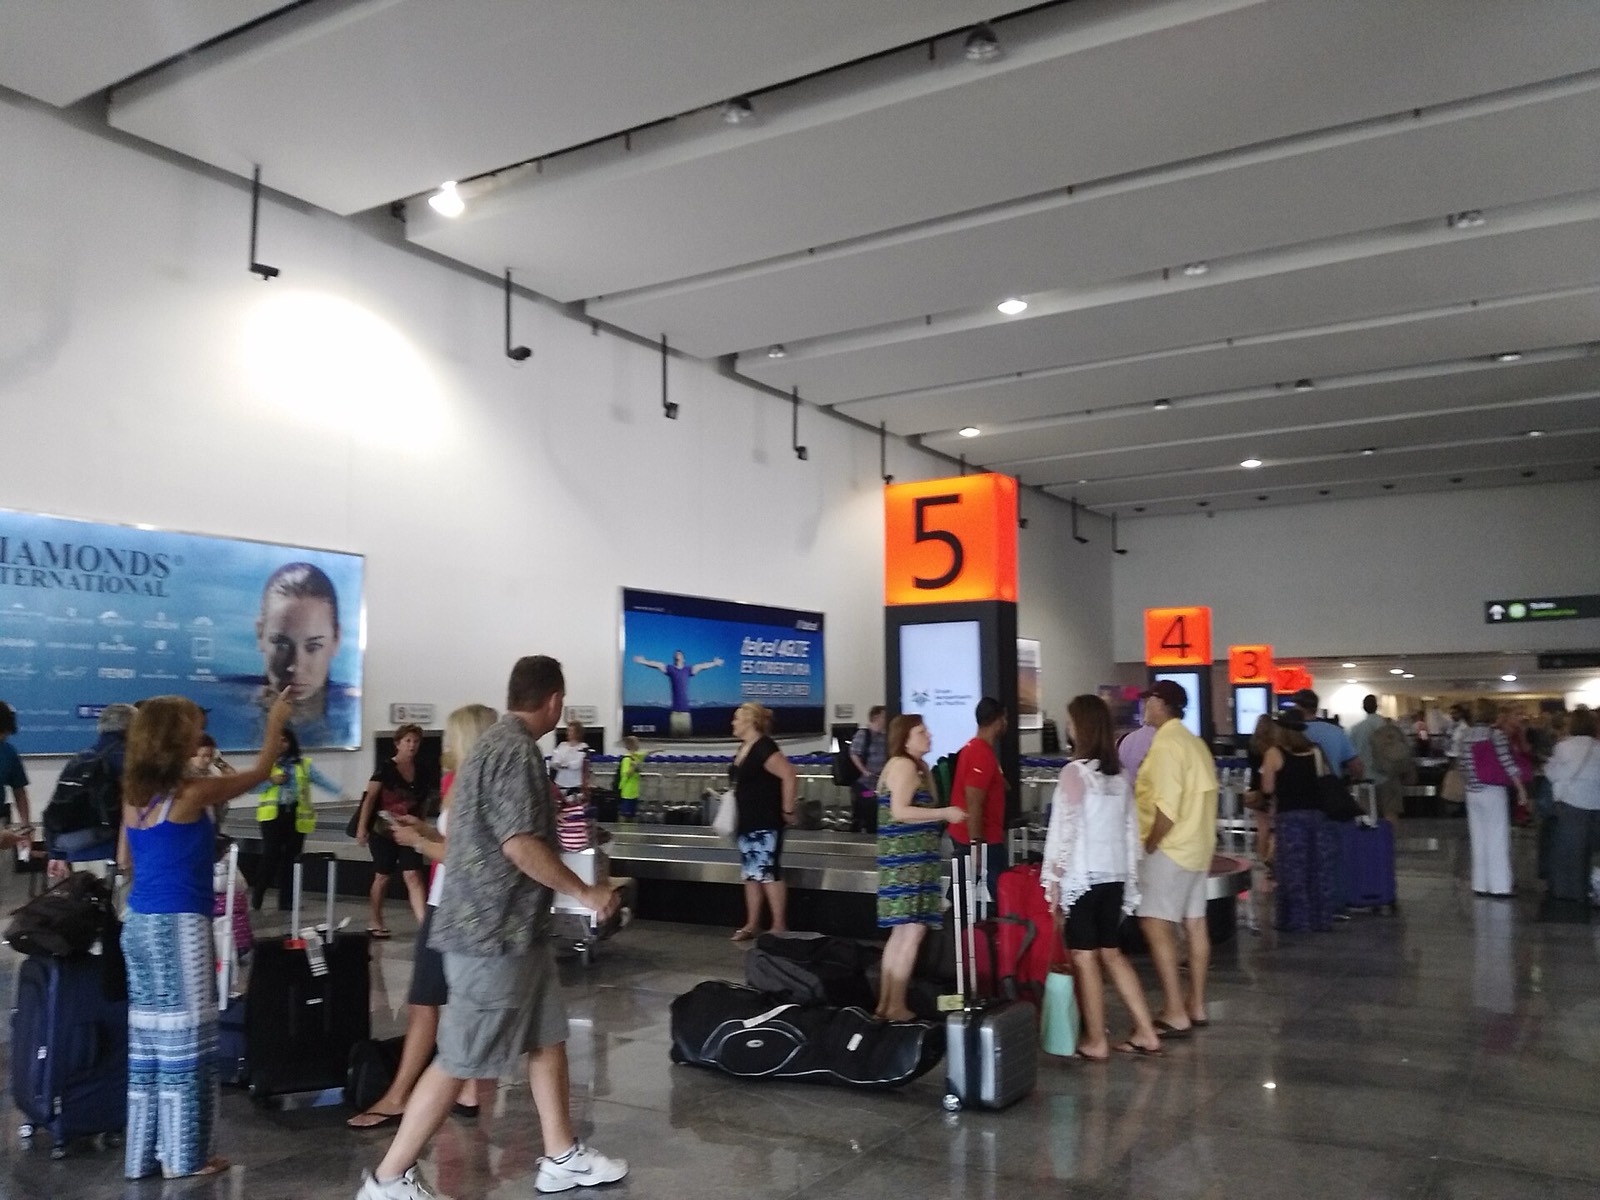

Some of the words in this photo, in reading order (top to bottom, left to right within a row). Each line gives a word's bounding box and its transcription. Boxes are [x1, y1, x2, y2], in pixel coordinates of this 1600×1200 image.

[912, 494, 964, 589] 5
[1161, 615, 1191, 658] 4
[1241, 651, 1259, 679] 3
[1282, 669, 1295, 691] 2
